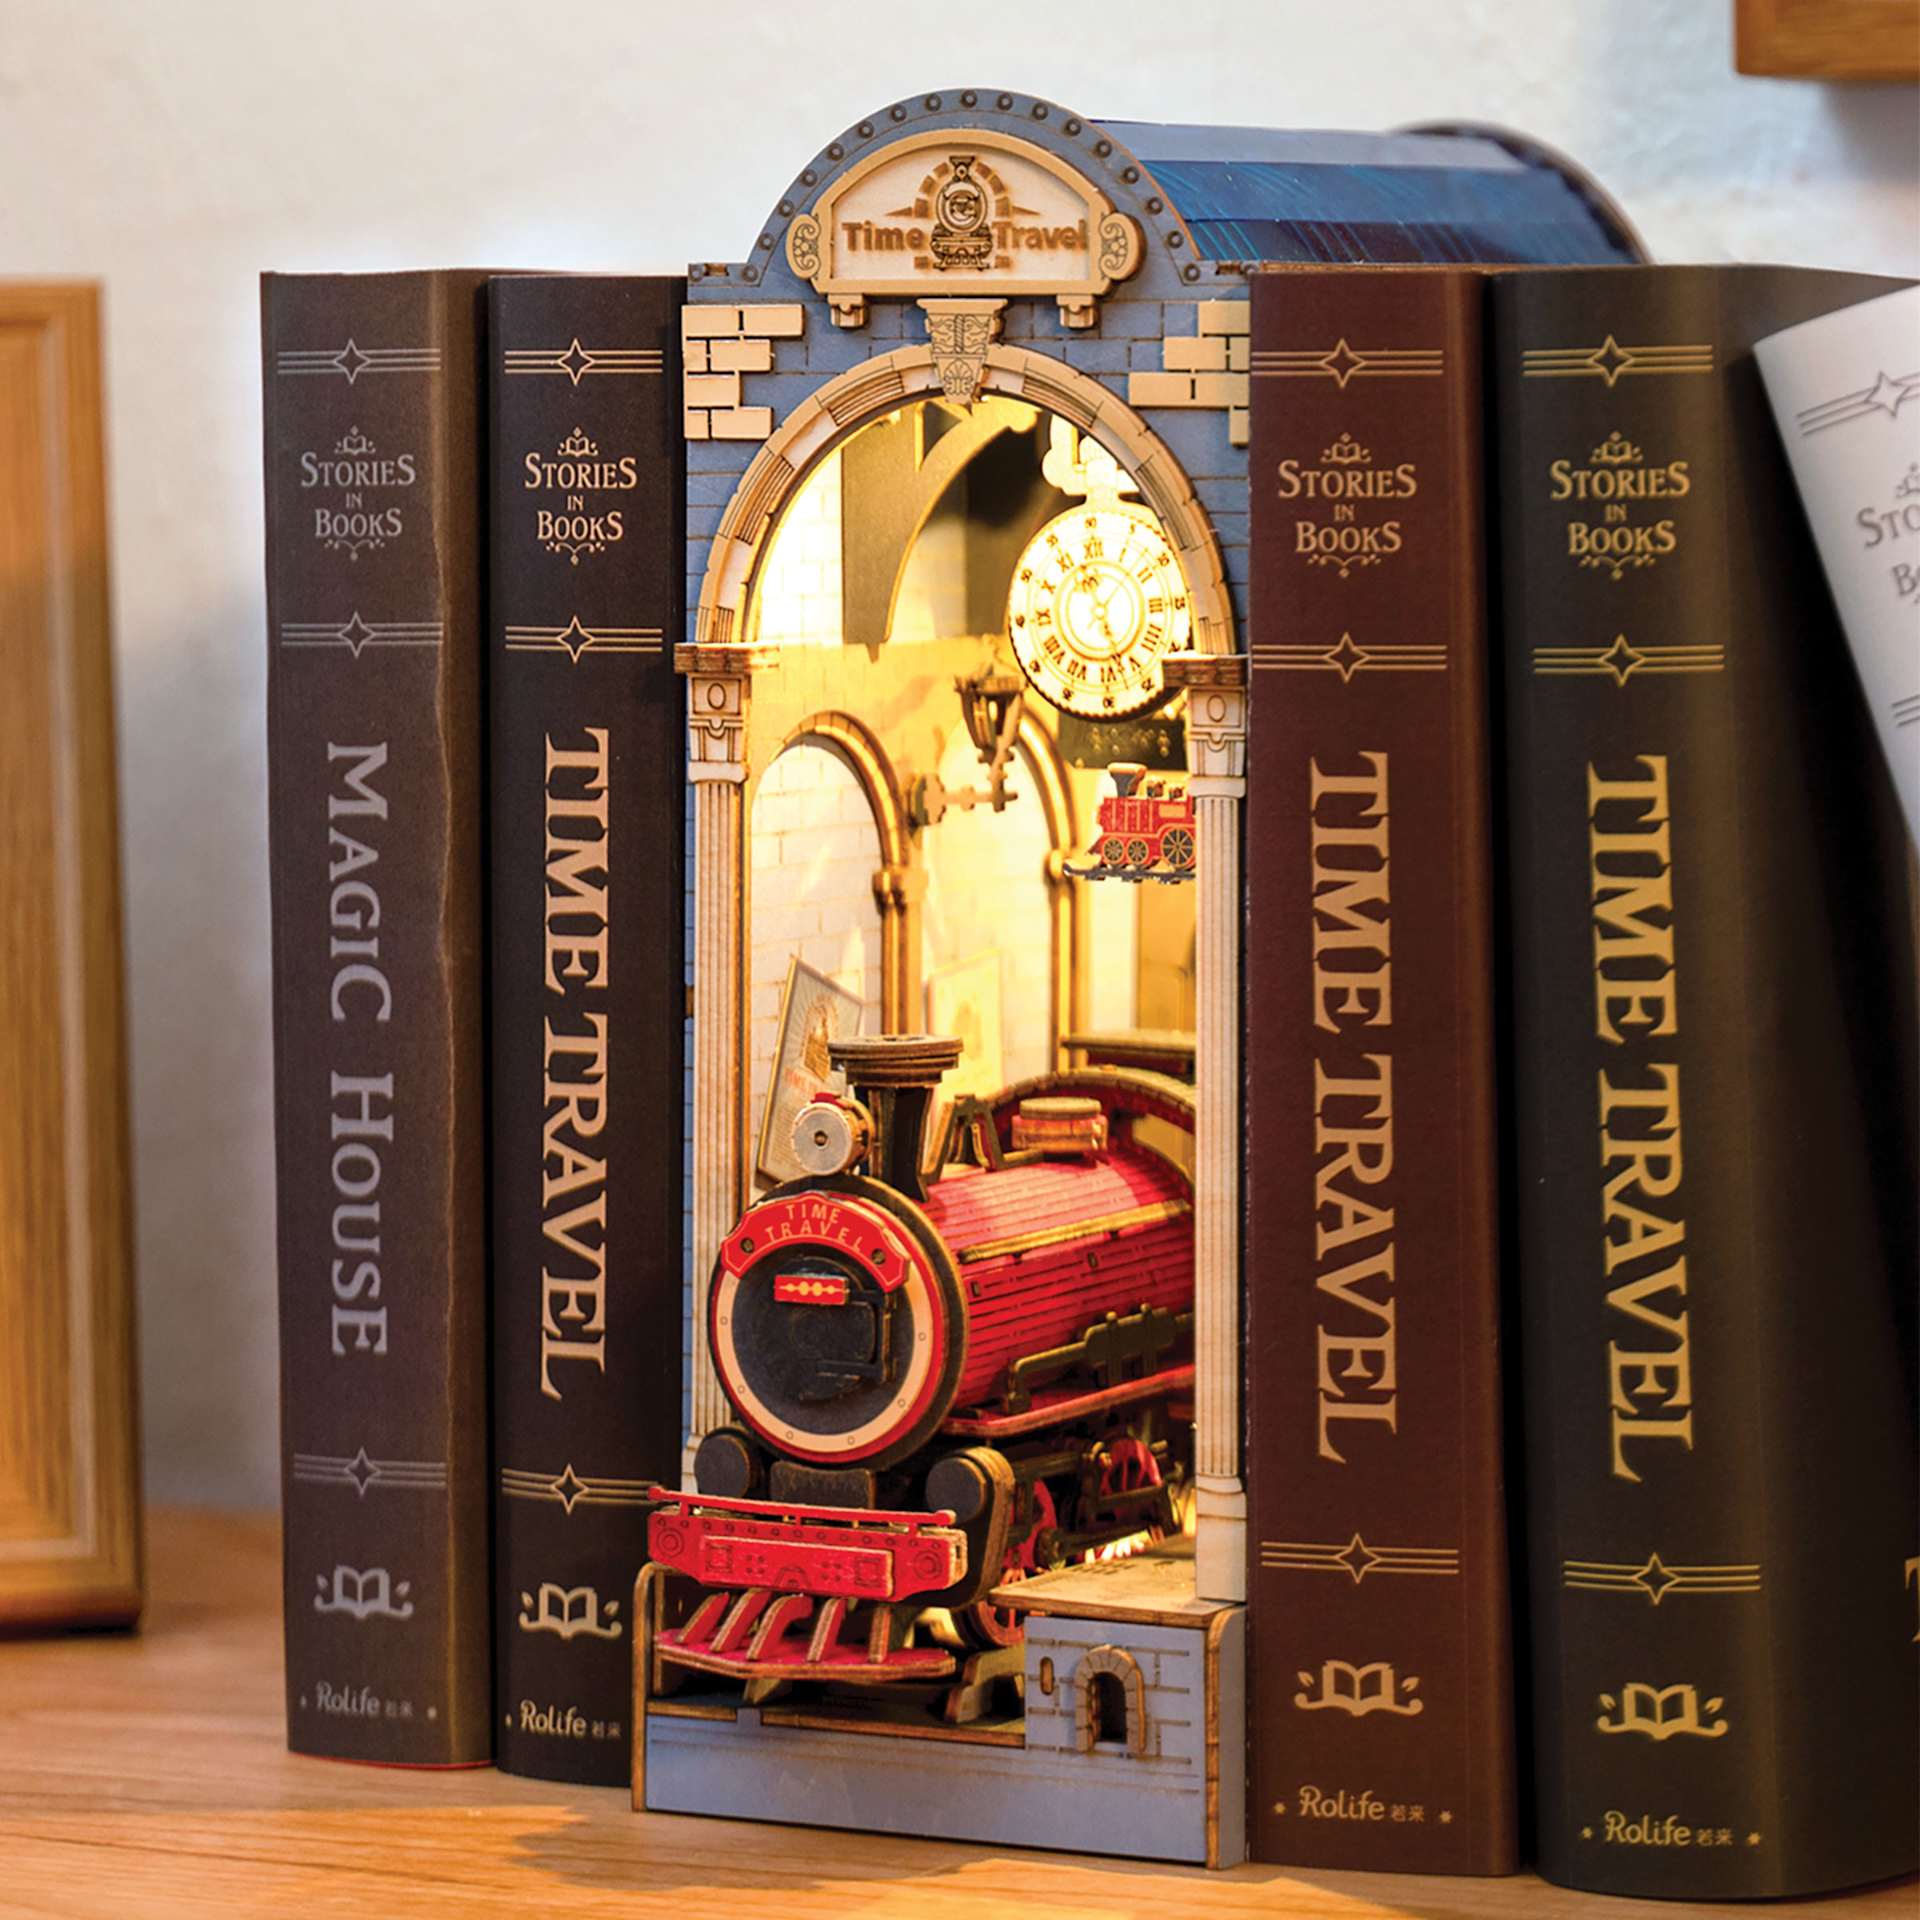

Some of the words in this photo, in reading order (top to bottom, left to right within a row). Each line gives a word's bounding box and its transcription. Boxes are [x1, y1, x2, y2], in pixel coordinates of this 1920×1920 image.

[842, 222, 926, 251] Time
[991, 219, 1088, 251] Travel
[301, 451, 416, 487] STORIES
[524, 452, 638, 489] STORIES
[1278, 459, 1417, 500] STORIES
[1550, 460, 1691, 501] STORIES
[345, 493, 362, 508] IN
[567, 495, 584, 511] IN
[1334, 504, 1354, 520] IN
[1606, 504, 1626, 521] IN
[315, 508, 402, 538] BOOKS
[537, 511, 624, 541] BOOKS
[1296, 521, 1402, 554] BOOKS
[1568, 520, 1677, 556] BOOKS
[1055, 551, 1075, 573] XI
[1084, 540, 1104, 560] XII
[1041, 580, 1057, 595] X
[1149, 598, 1163, 614] III
[544, 727, 609, 996] TIME
[327, 741, 393, 1023] MAGIC
[1309, 750, 1392, 1034] TIME
[1587, 754, 1678, 1044] TIME
[330, 1070, 395, 1356] HOUSE
[540, 1012, 608, 1400] TRAVEL
[786, 1203, 841, 1224] TIME
[765, 1220, 863, 1252] TRAVEL
[1314, 1053, 1397, 1465] TRAVEL
[1598, 1063, 1693, 1483] TRAVEL
[316, 1681, 380, 1717] Rolife
[520, 1700, 586, 1736] Rolife
[1299, 1785, 1385, 1821] Rolife
[1604, 1810, 1691, 1846] Rolife
